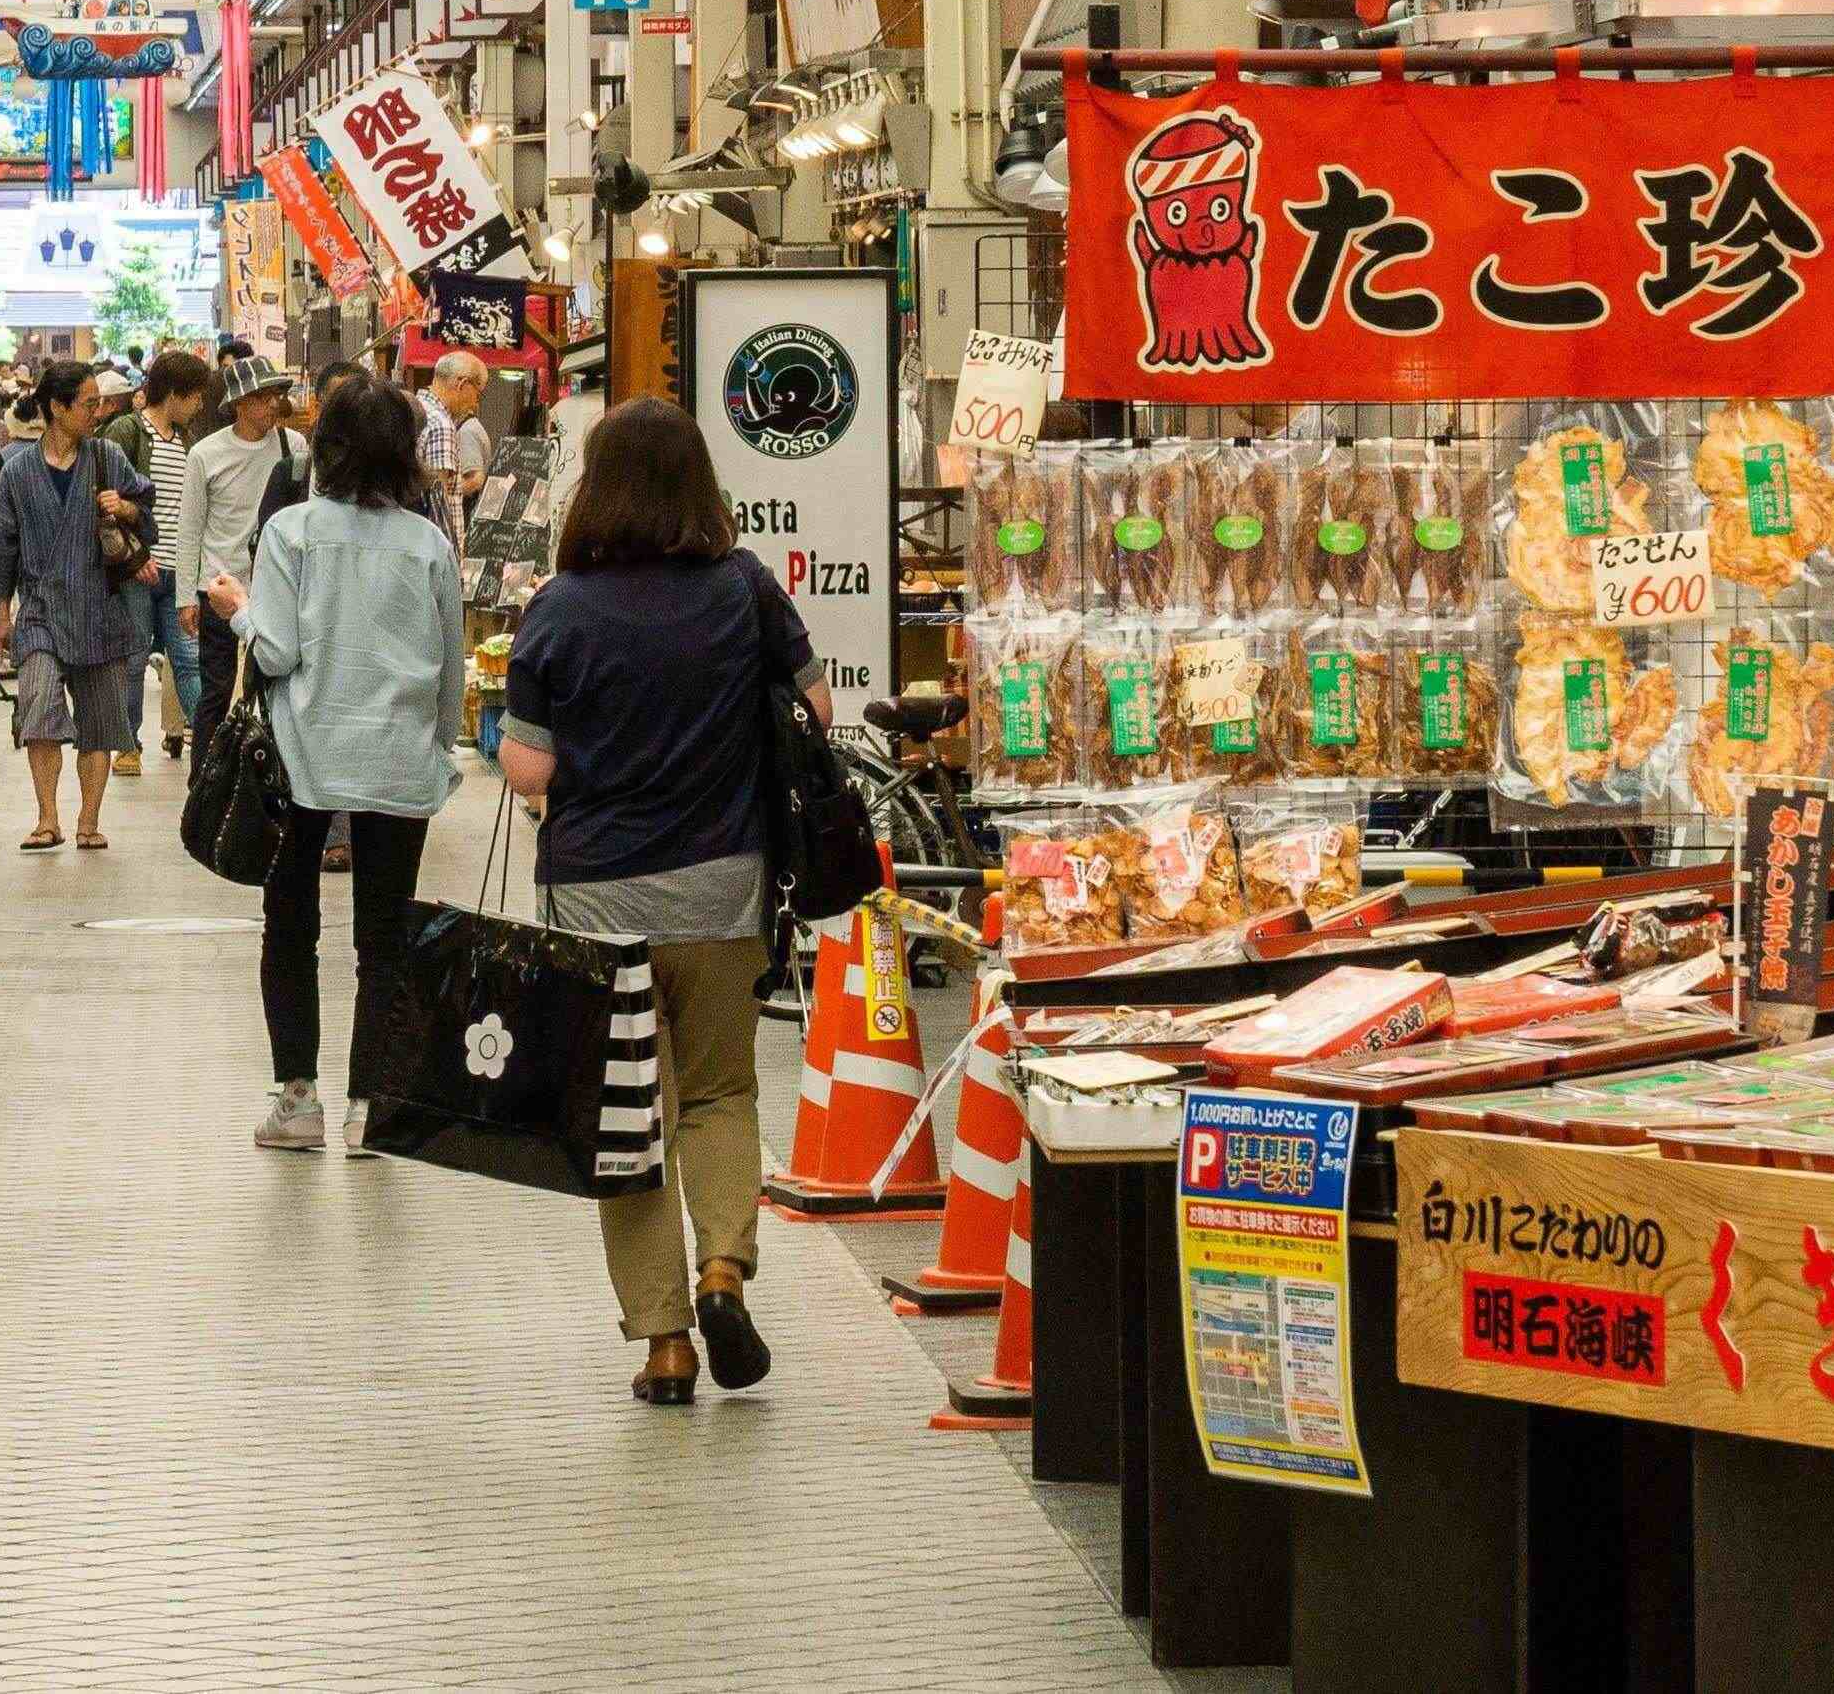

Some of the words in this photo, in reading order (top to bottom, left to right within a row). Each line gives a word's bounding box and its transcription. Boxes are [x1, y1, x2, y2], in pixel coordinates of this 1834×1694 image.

[752, 329, 794, 355] Italian
[795, 328, 836, 360] Dining
[758, 430, 831, 455] ROSSO
[735, 498, 798, 533] asta
[1596, 535, 1698, 571] たこせん
[788, 551, 870, 595] Pizza
[1603, 573, 1708, 623] ¥600
[1191, 1132, 1216, 1184] P
[1226, 1133, 1315, 1166] 駐車割引券
[1226, 1163, 1314, 1195] サービス中
[1422, 1179, 1665, 1272] 白川こだわりの
[1471, 1287, 1656, 1378] 明石海峡
